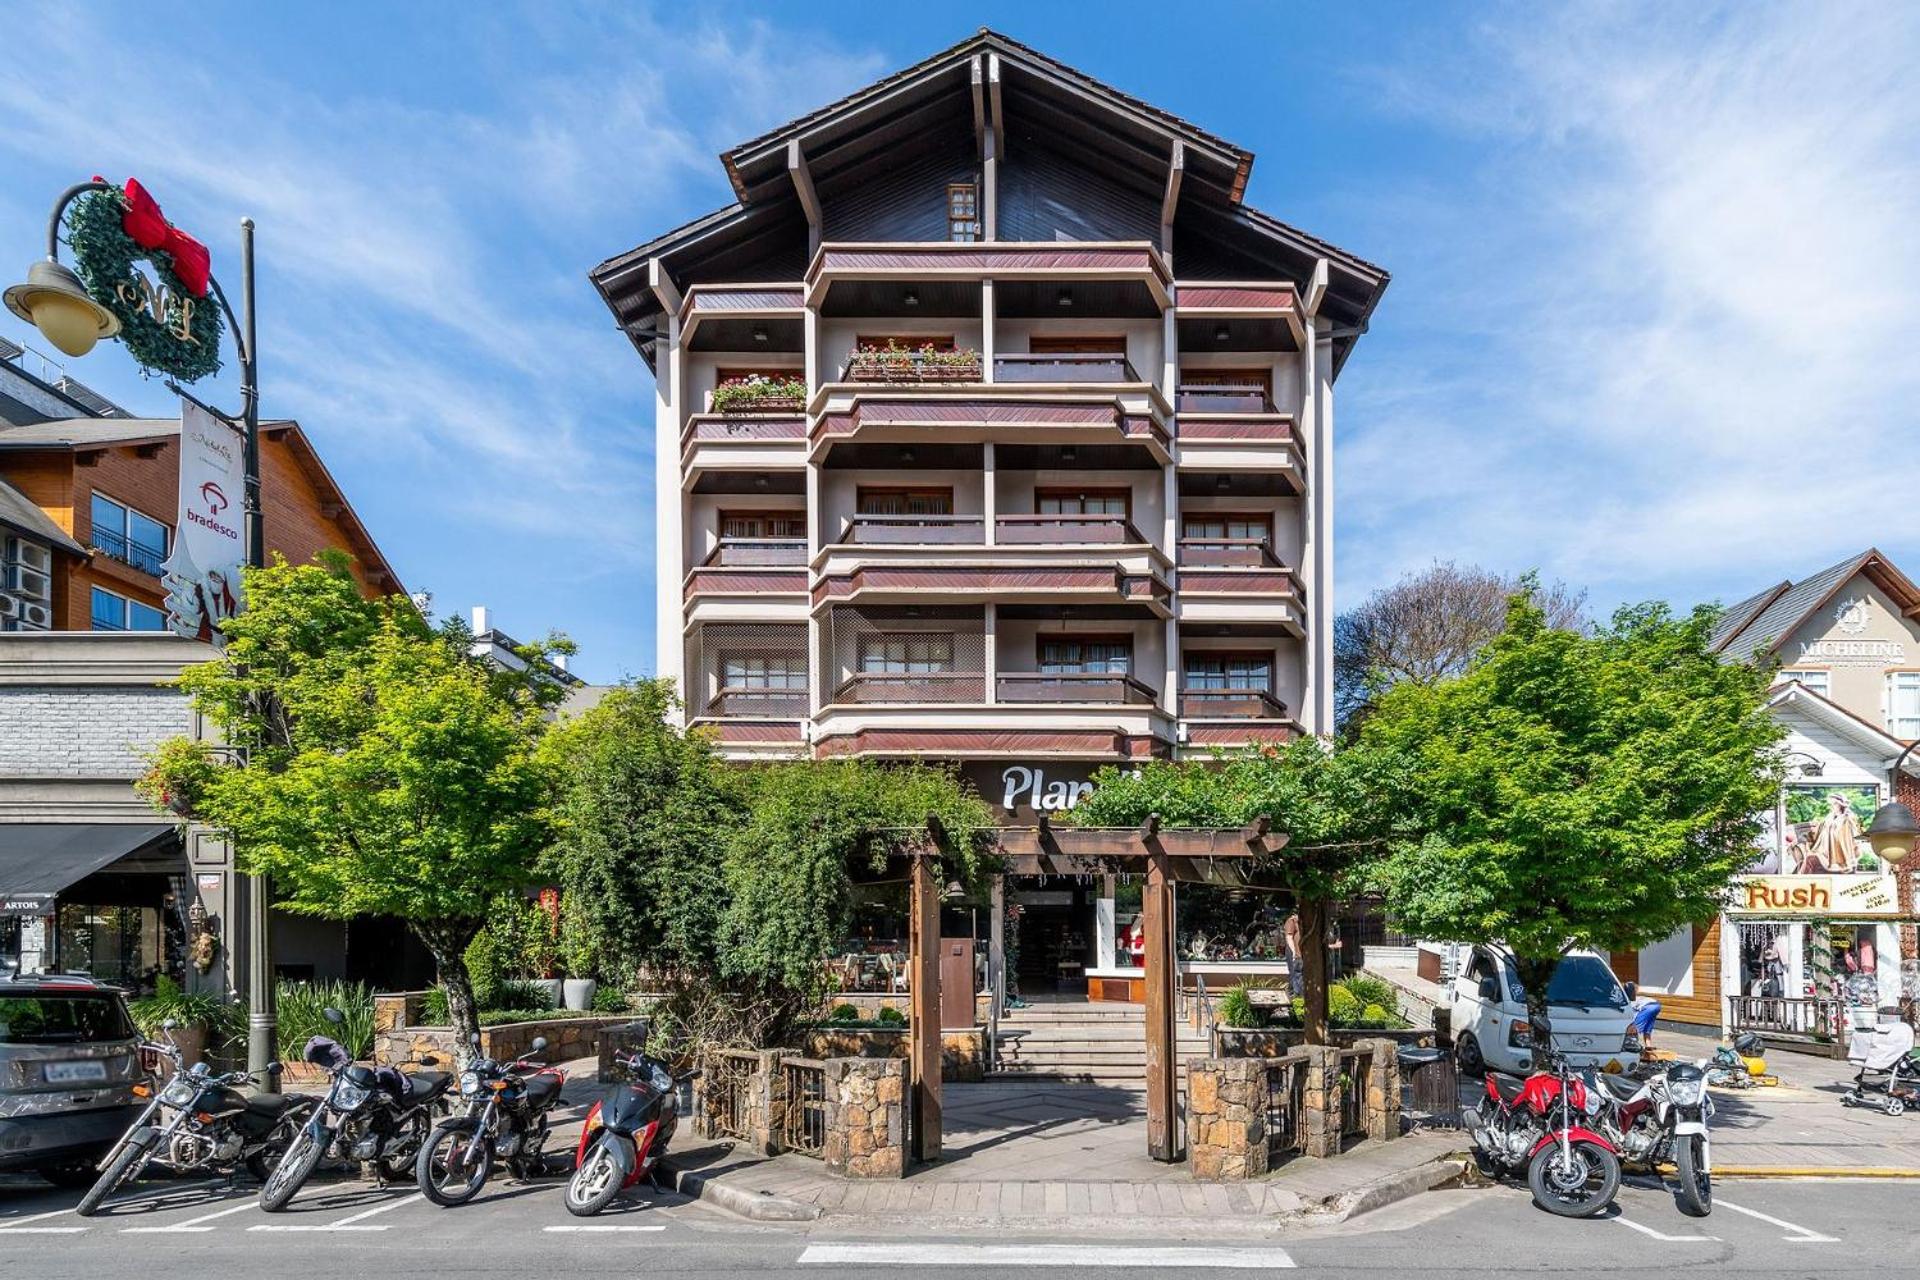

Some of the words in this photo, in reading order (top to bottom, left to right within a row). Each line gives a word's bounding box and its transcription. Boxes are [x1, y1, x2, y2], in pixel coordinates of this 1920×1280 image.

[187, 508, 238, 540] bradesco
[4, 901, 40, 910] ARTOIS
[1749, 882, 1829, 909] Rush
